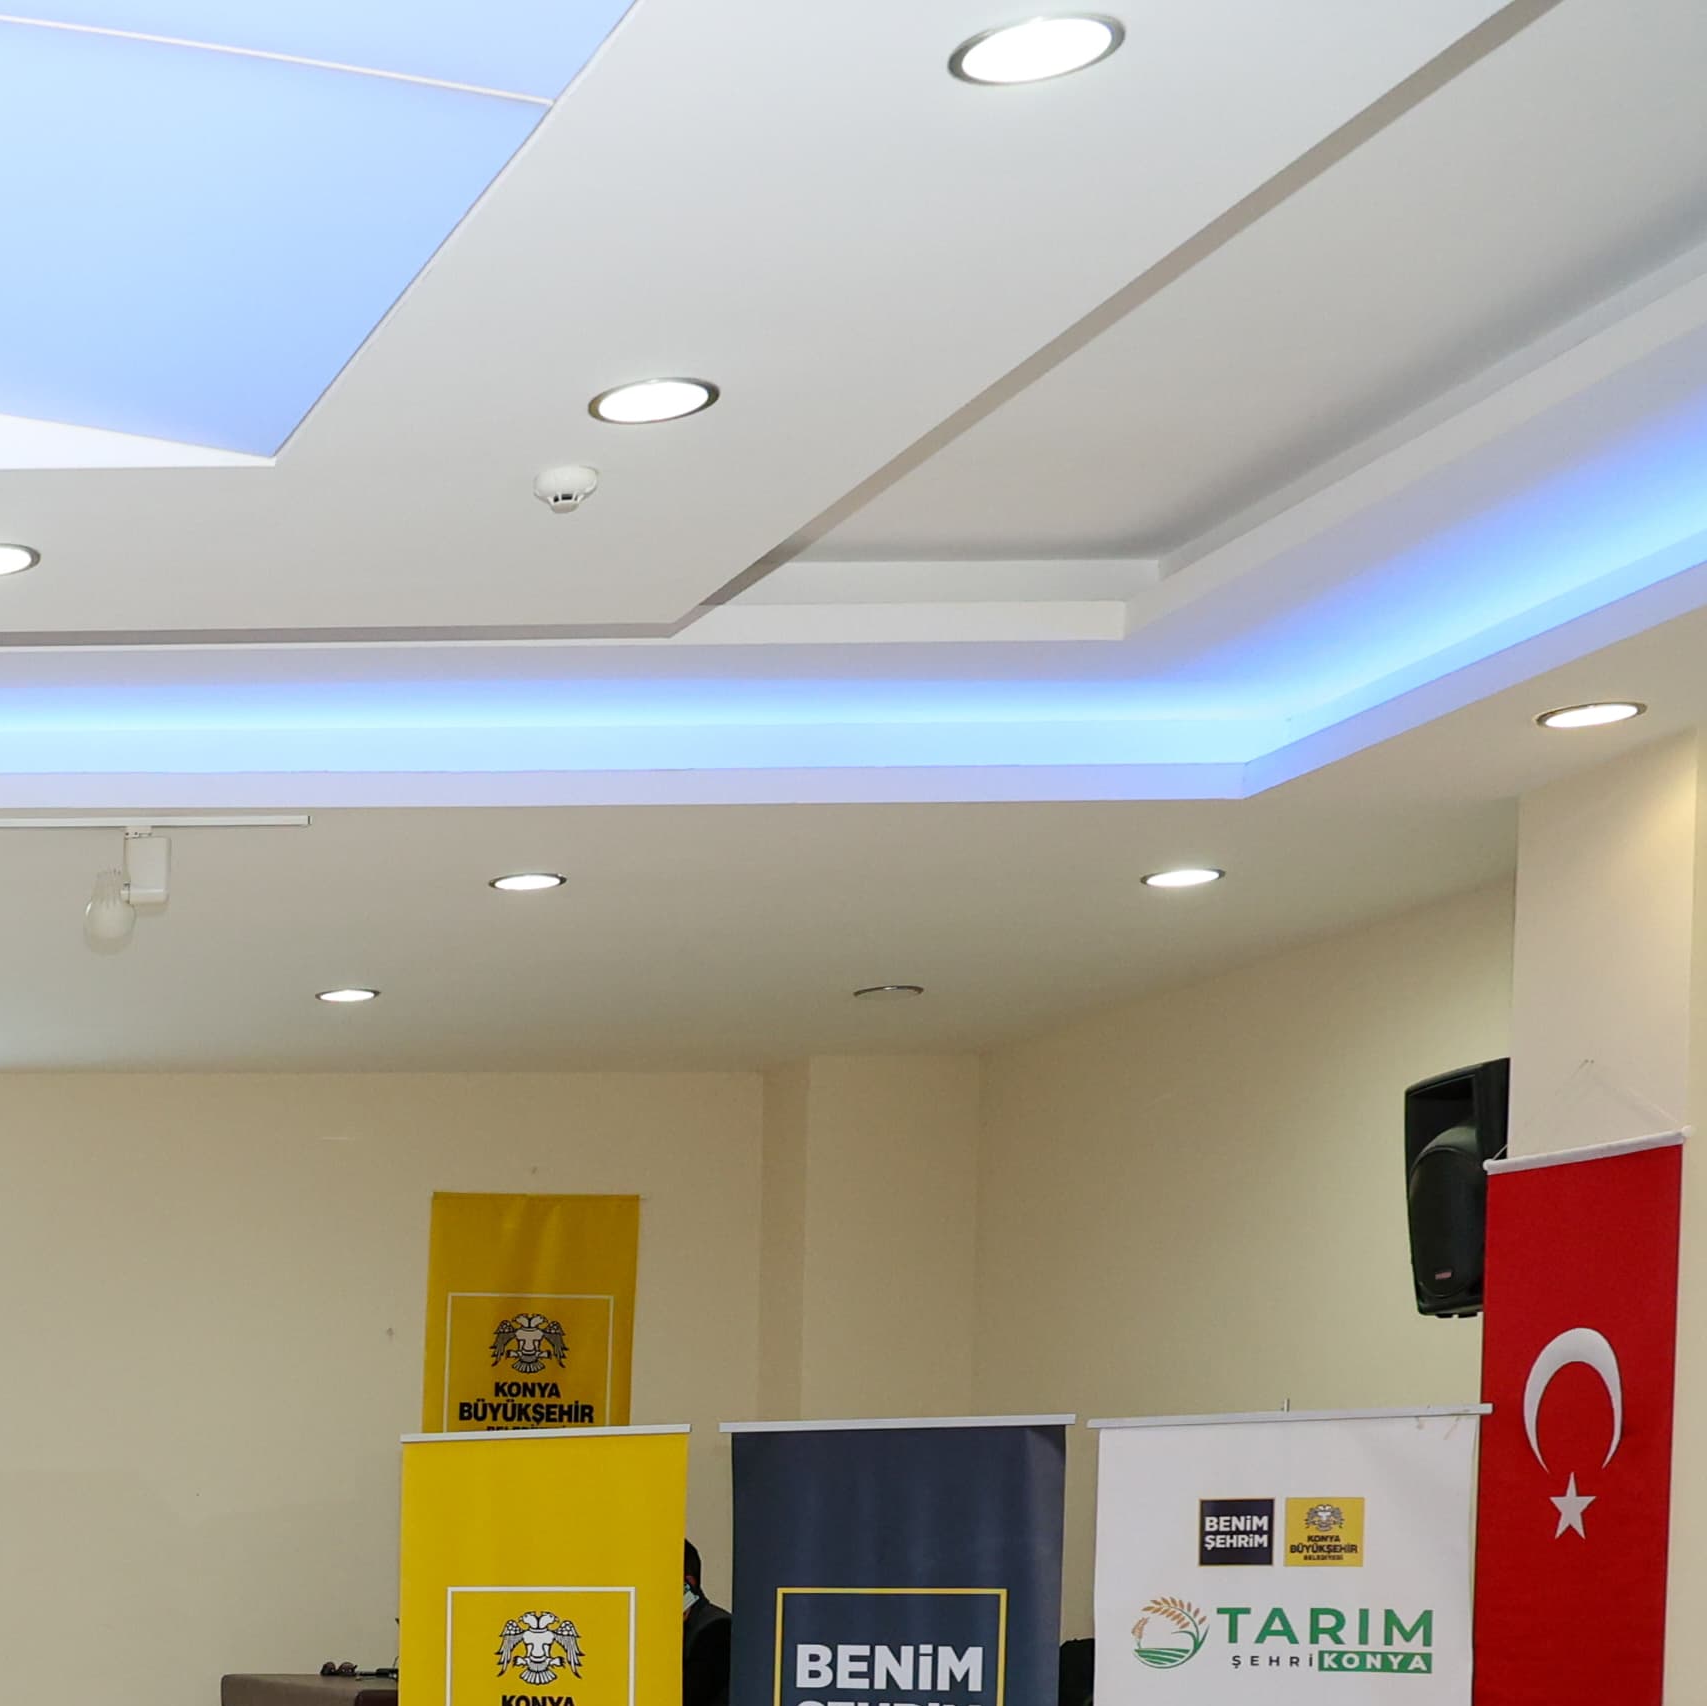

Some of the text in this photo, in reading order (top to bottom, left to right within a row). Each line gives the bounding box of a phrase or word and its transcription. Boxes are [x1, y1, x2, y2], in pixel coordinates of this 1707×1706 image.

[494, 1382, 562, 1399] KONYA
[458, 1398, 595, 1425] BÜYÜKŞEHİR
[1216, 1606, 1434, 1648] TARIM
[1231, 1651, 1428, 1671] ŞEHRİ KONYA
